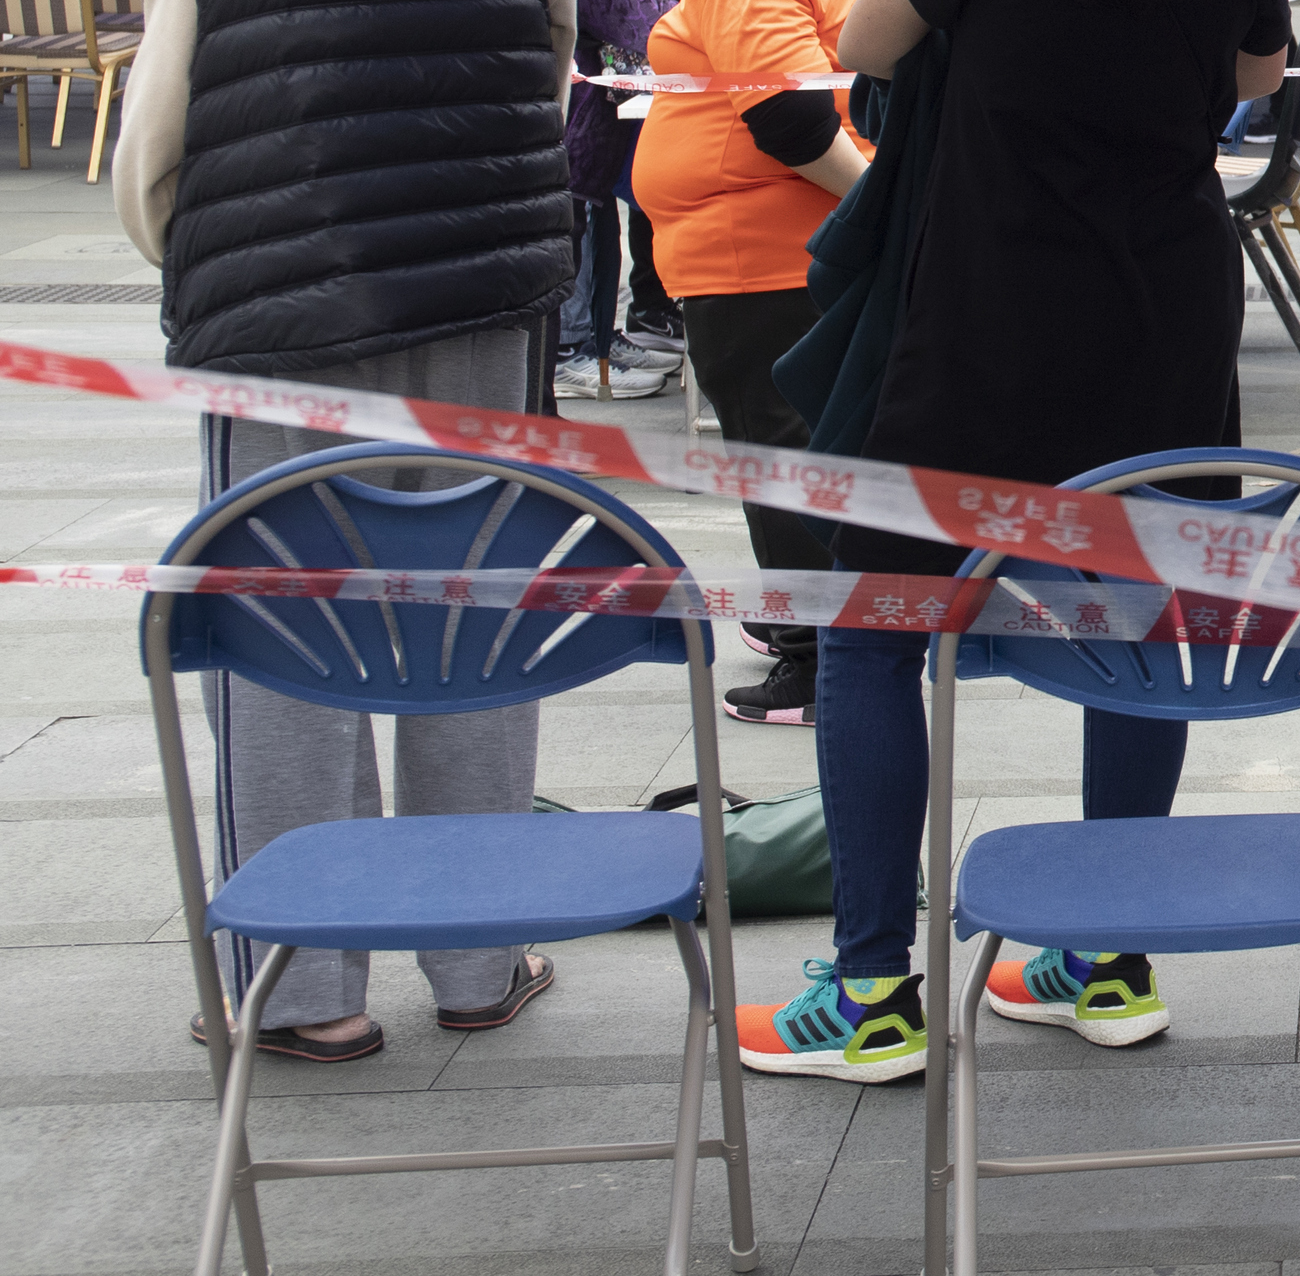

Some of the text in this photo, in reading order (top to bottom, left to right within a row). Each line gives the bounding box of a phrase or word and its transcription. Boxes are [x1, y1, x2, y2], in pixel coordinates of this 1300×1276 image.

[383, 575, 474, 598] 注意
[555, 581, 631, 607] 安全
[703, 588, 793, 612] 注意
[873, 595, 948, 619] 安全
[688, 609, 795, 621] CAUTION
[862, 616, 941, 627] SAFE
[1020, 601, 1109, 624] 注意
[1188, 607, 1262, 630] 安全
[1004, 620, 1110, 634] CAUTION
[1176, 627, 1253, 641] SAFE
